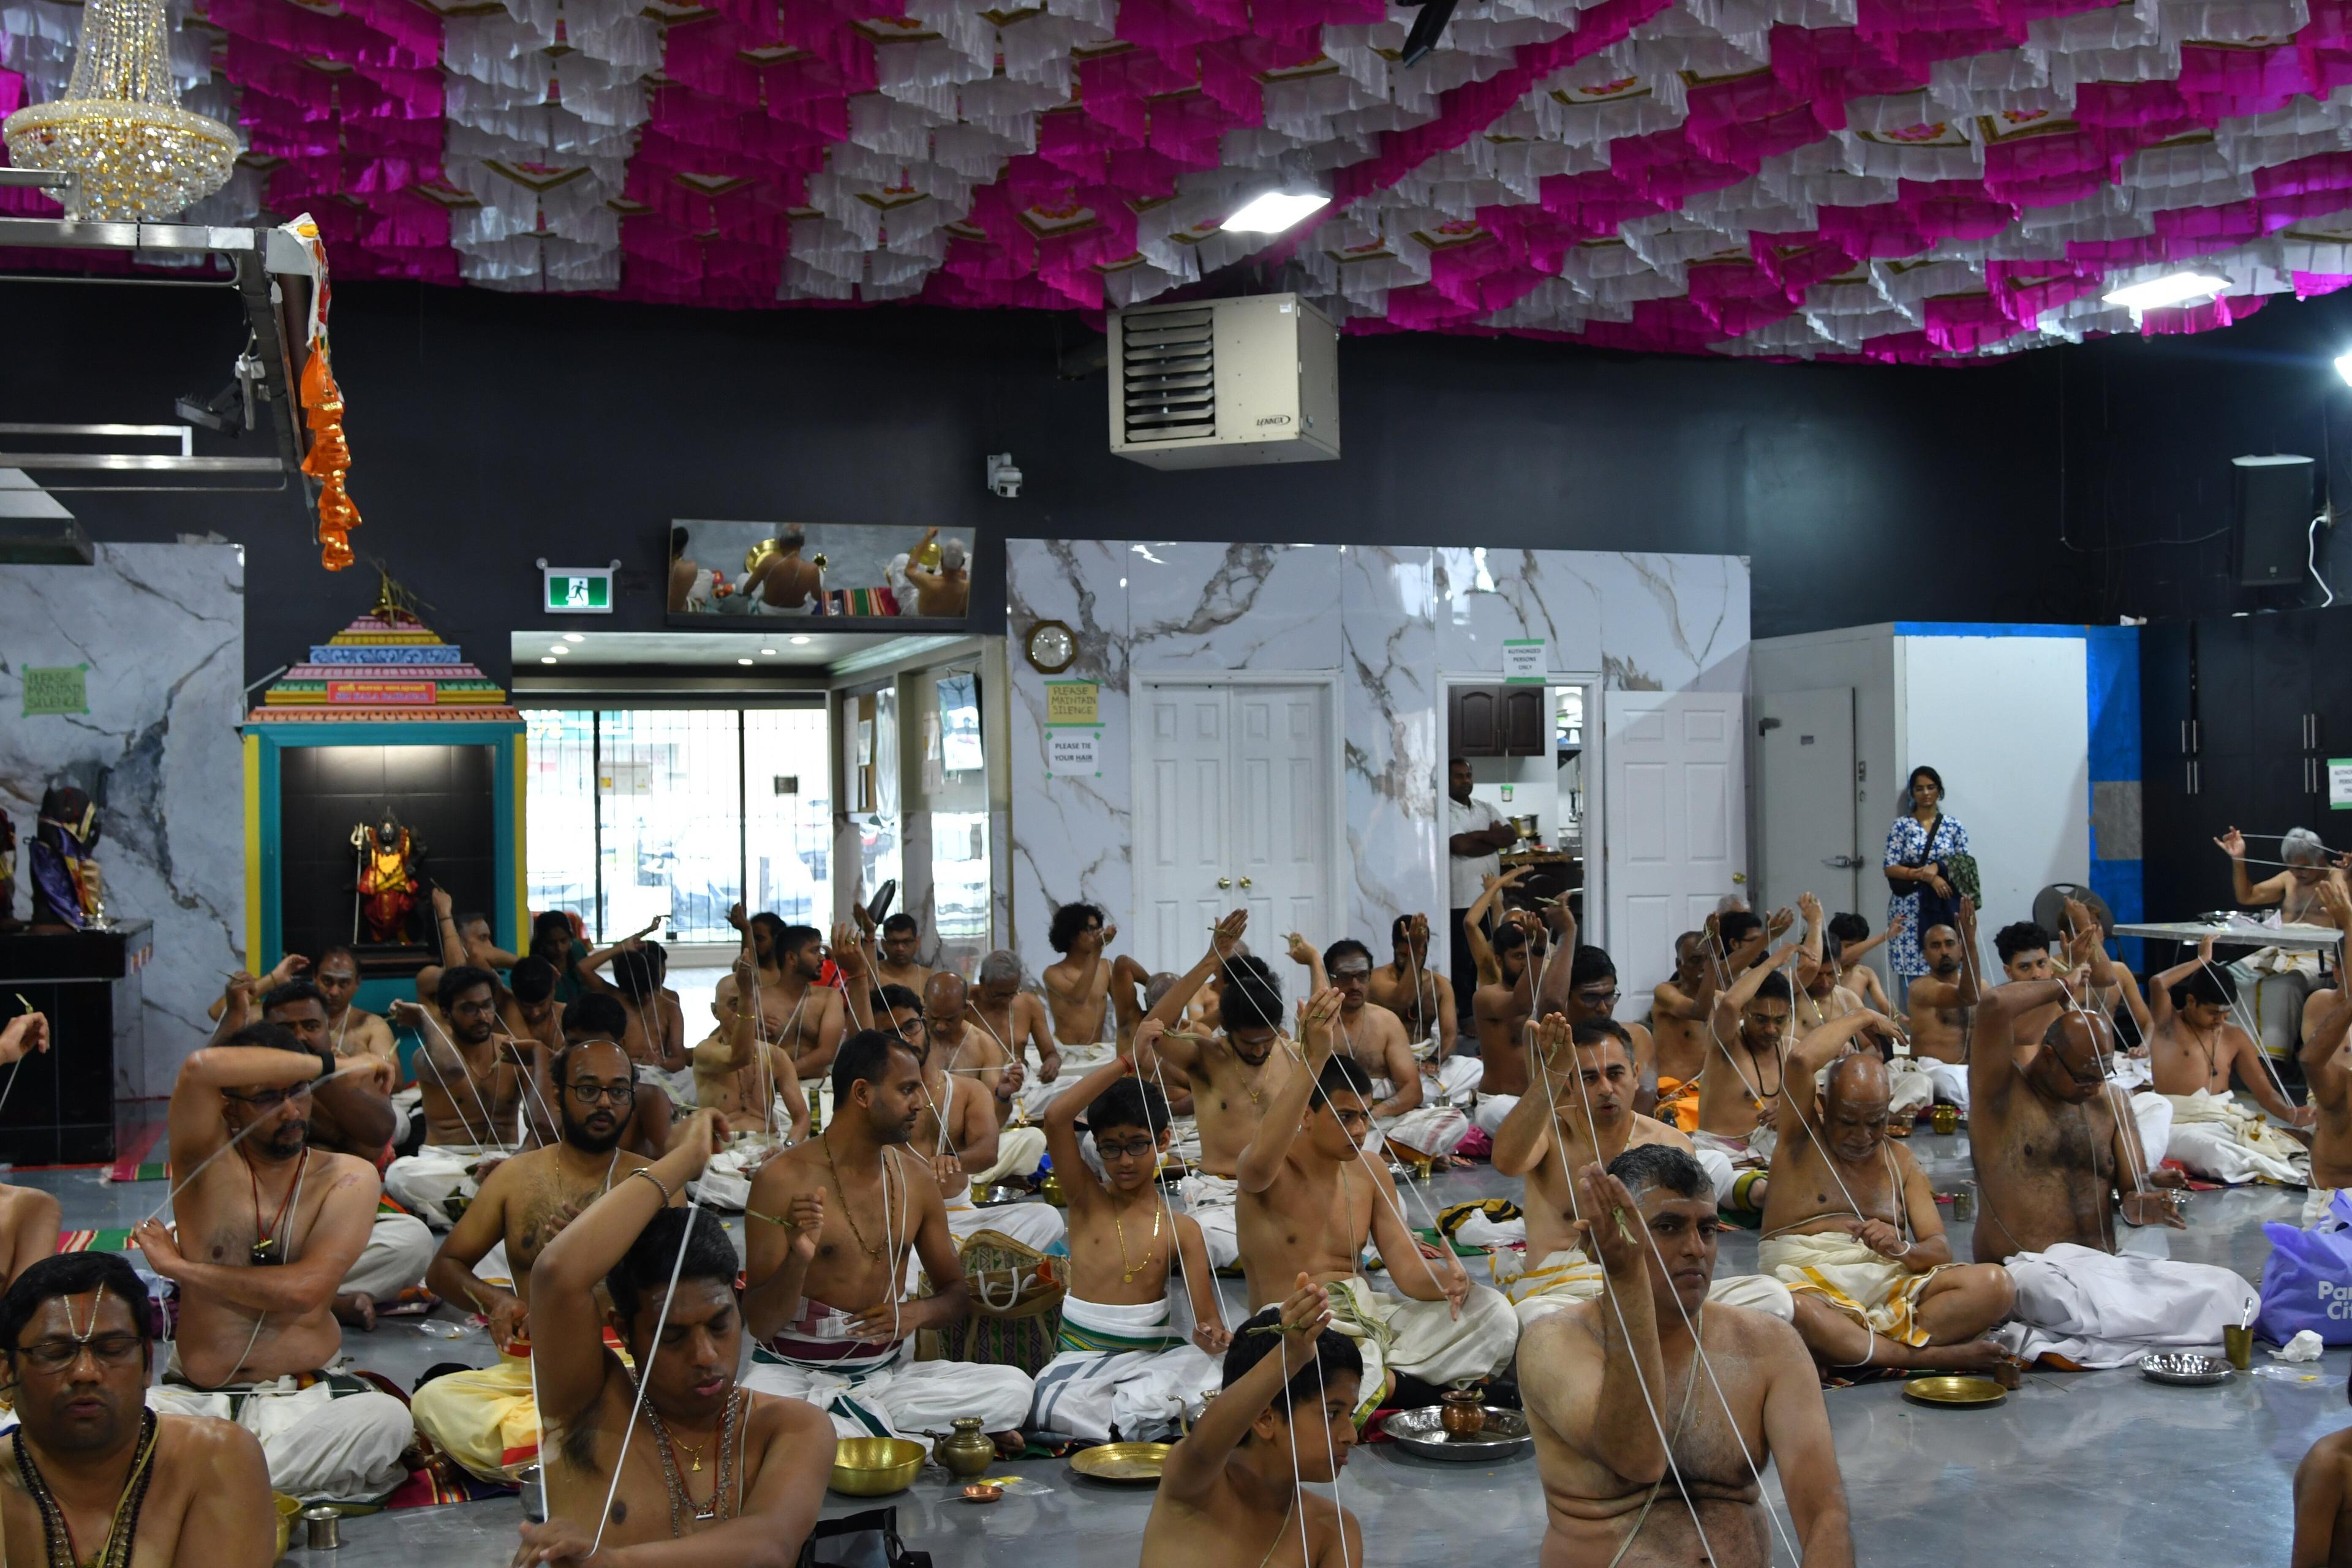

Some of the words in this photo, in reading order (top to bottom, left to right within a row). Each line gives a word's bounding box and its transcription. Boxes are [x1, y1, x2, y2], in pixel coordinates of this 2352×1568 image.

[1053, 687, 1088, 696] PLEASE
[27, 697, 80, 709] SILENCE
[1052, 706, 1093, 715] SILENCE
